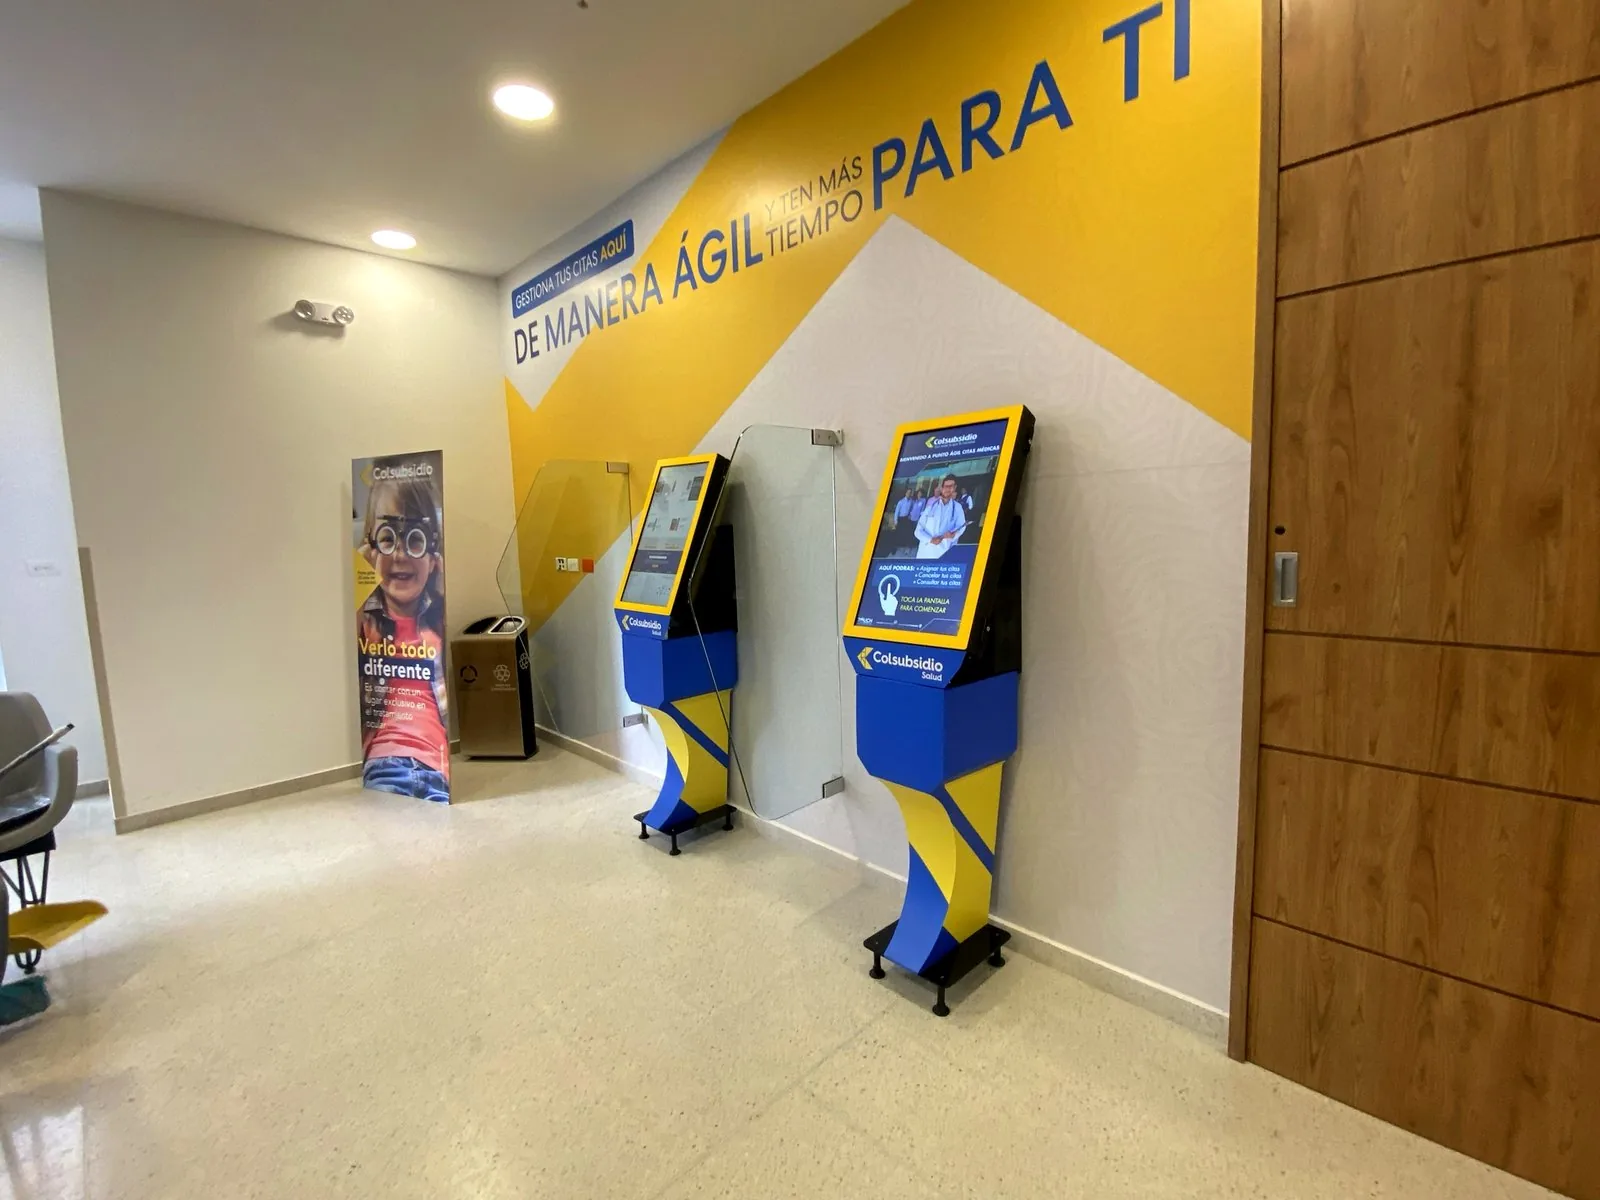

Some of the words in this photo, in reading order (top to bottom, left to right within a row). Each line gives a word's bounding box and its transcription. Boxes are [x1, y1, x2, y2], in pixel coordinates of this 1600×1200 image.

[872, 59, 1074, 212] PARA
[1102, 0, 1190, 103] TI
[765, 200, 776, 221] Y
[780, 180, 812, 214] TEN
[819, 156, 863, 197] MÁS
[765, 189, 863, 257] TIEMPO
[515, 276, 555, 309] GESTIONA
[555, 266, 572, 288] TUS
[572, 250, 599, 277] CITAS
[600, 228, 627, 262] AQUÍ
[514, 320, 540, 365] DE
[544, 262, 664, 352] MANERA
[672, 212, 763, 300] ÁGIL
[934, 433, 978, 445] Colsubsidio
[976, 445, 1000, 453] MÉDICAS
[373, 463, 433, 480] Colsubsidio
[920, 565, 939, 573] Asignar
[900, 604, 913, 612] PARA
[914, 605, 947, 614] COMENZAR
[924, 597, 950, 605] PANTALLA
[629, 617, 662, 630] Colsubsidio
[358, 637, 397, 656] Verlo
[400, 640, 437, 659] todo
[364, 658, 431, 680] diferente
[873, 650, 943, 672] Colsubsidio
[921, 671, 943, 682] Salud
[384, 697, 415, 709] exclusivo
